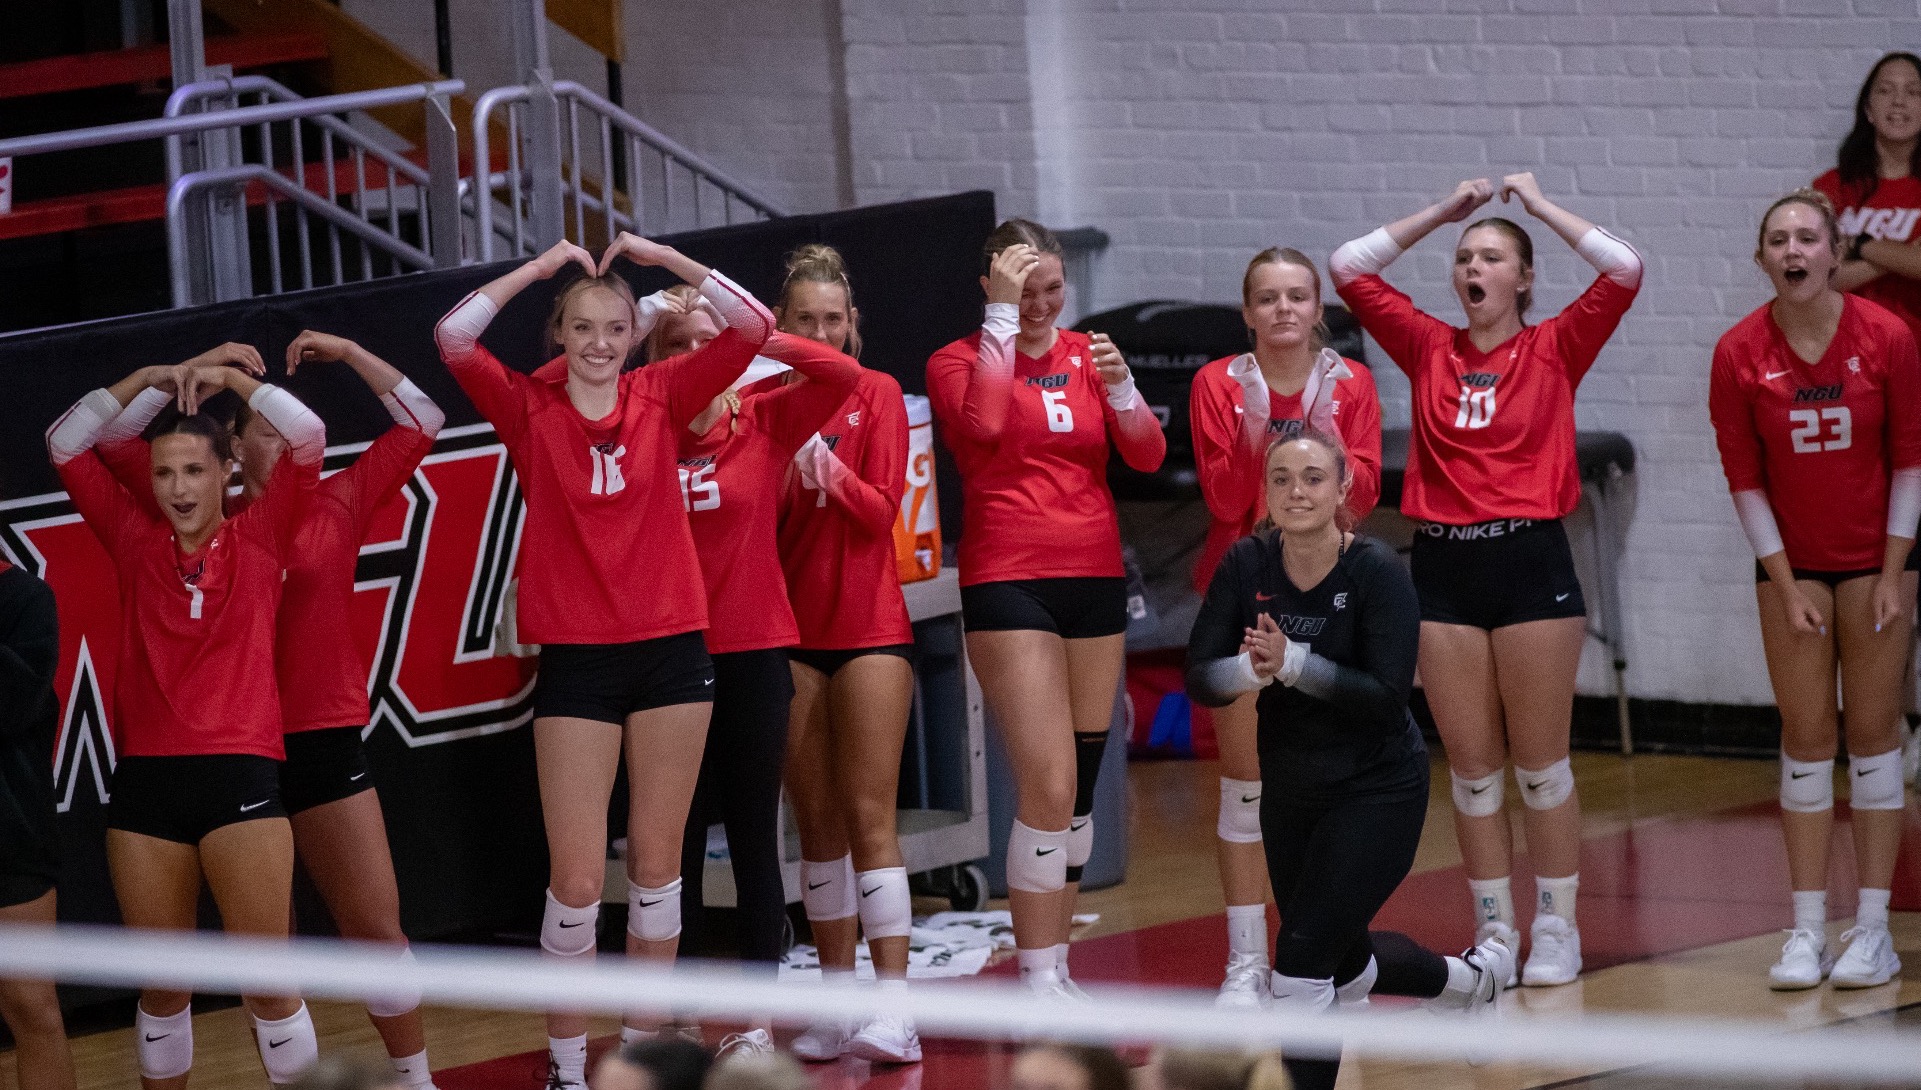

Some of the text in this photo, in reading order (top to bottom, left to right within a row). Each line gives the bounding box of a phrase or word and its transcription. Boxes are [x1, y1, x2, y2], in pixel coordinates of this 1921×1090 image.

[1838, 207, 1919, 241] NGU
[1041, 390, 1074, 432] 6
[1455, 386, 1496, 428] 10
[1793, 384, 1843, 402] NGU
[1789, 406, 1852, 453] 23
[590, 444, 626, 495] 16
[677, 463, 721, 512] 15
[1448, 520, 1506, 540] NIKE
[1278, 614, 1327, 636] NGU
